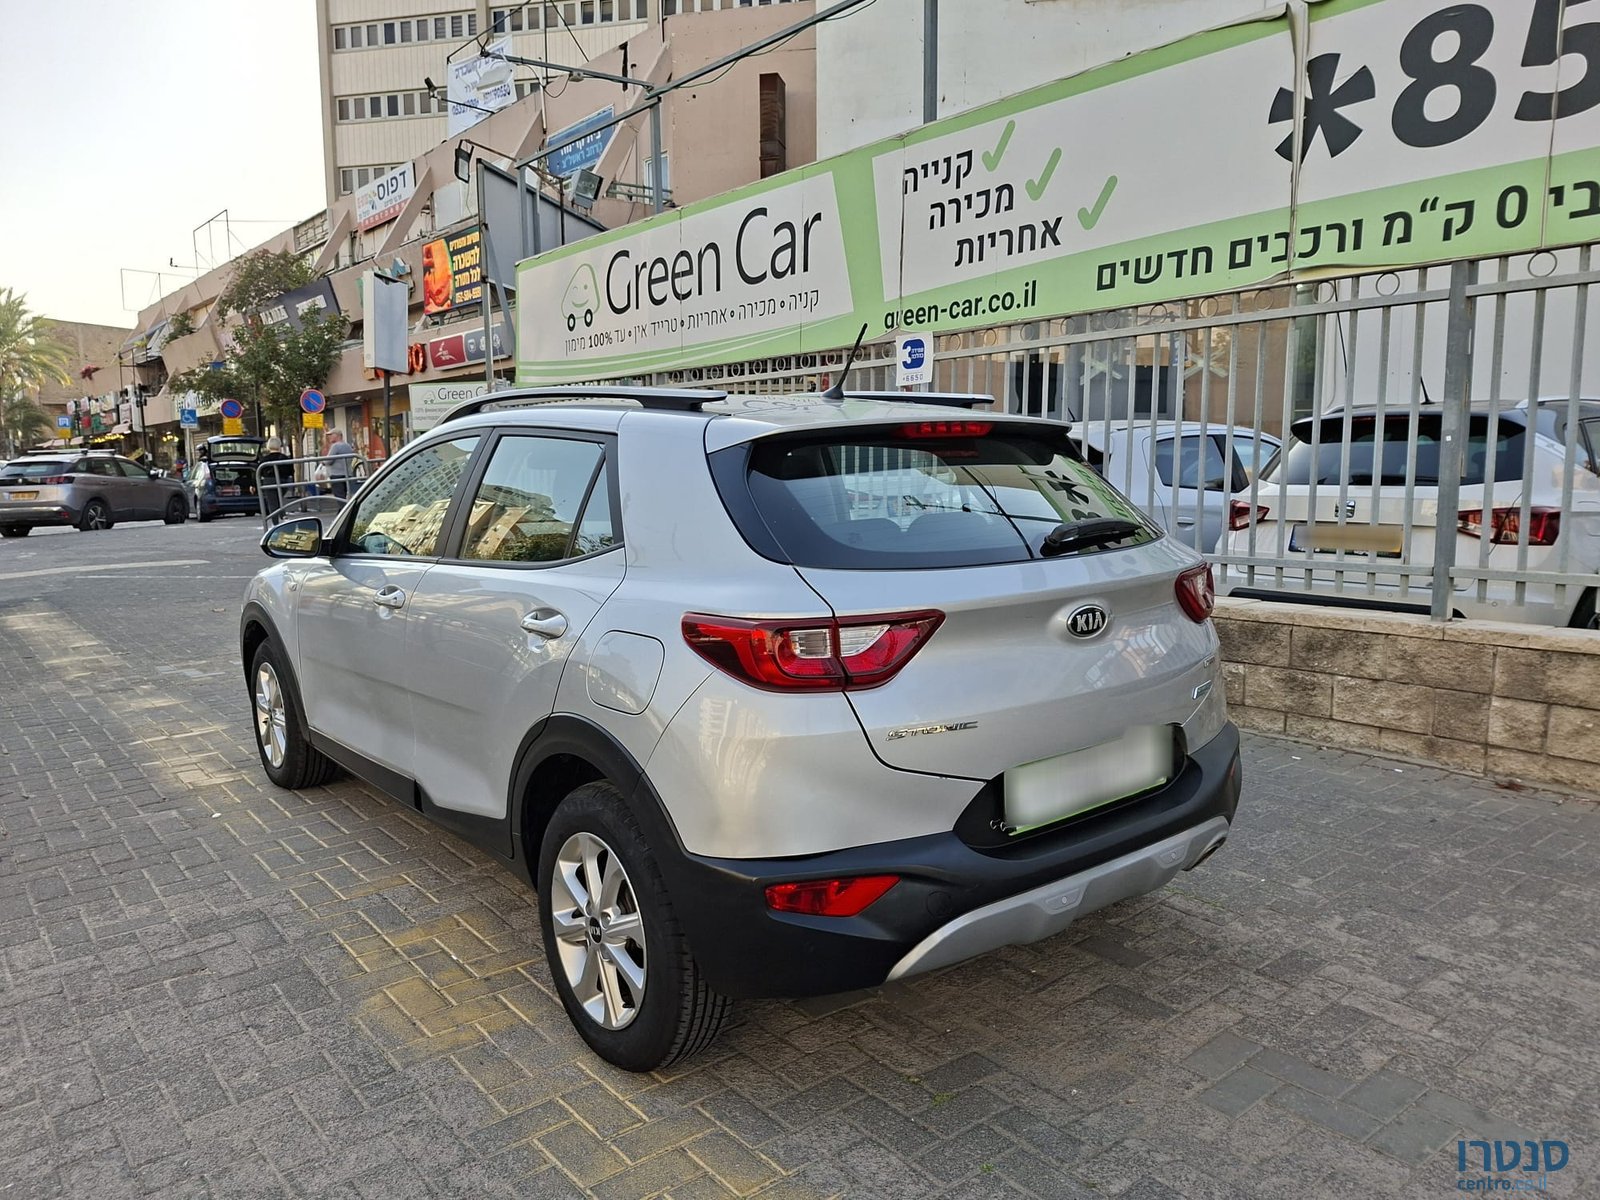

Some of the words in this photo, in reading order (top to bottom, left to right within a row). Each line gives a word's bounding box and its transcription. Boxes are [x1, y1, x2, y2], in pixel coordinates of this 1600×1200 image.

[904, 149, 973, 195] קנייה
[377, 170, 406, 200] דפוס
[929, 183, 1014, 230] מכירה
[954, 216, 1063, 267] אחריות
[1228, 218, 1362, 270] ורכבים
[606, 241, 721, 315] Green
[736, 207, 822, 285] Car
[1096, 245, 1213, 291] חדשים
[738, 298, 776, 320] מכירה
[789, 290, 819, 312] קניה
[884, 279, 1037, 331] green-car.co.il
[651, 318, 678, 336] טרייד
[687, 308, 727, 330] אחריות
[588, 331, 613, 348] 100%
[614, 328, 626, 343] עד
[633, 323, 648, 344] אין
[565, 337, 586, 356] מימון
[437, 387, 473, 401] Green
[1075, 611, 1103, 632] KIA
